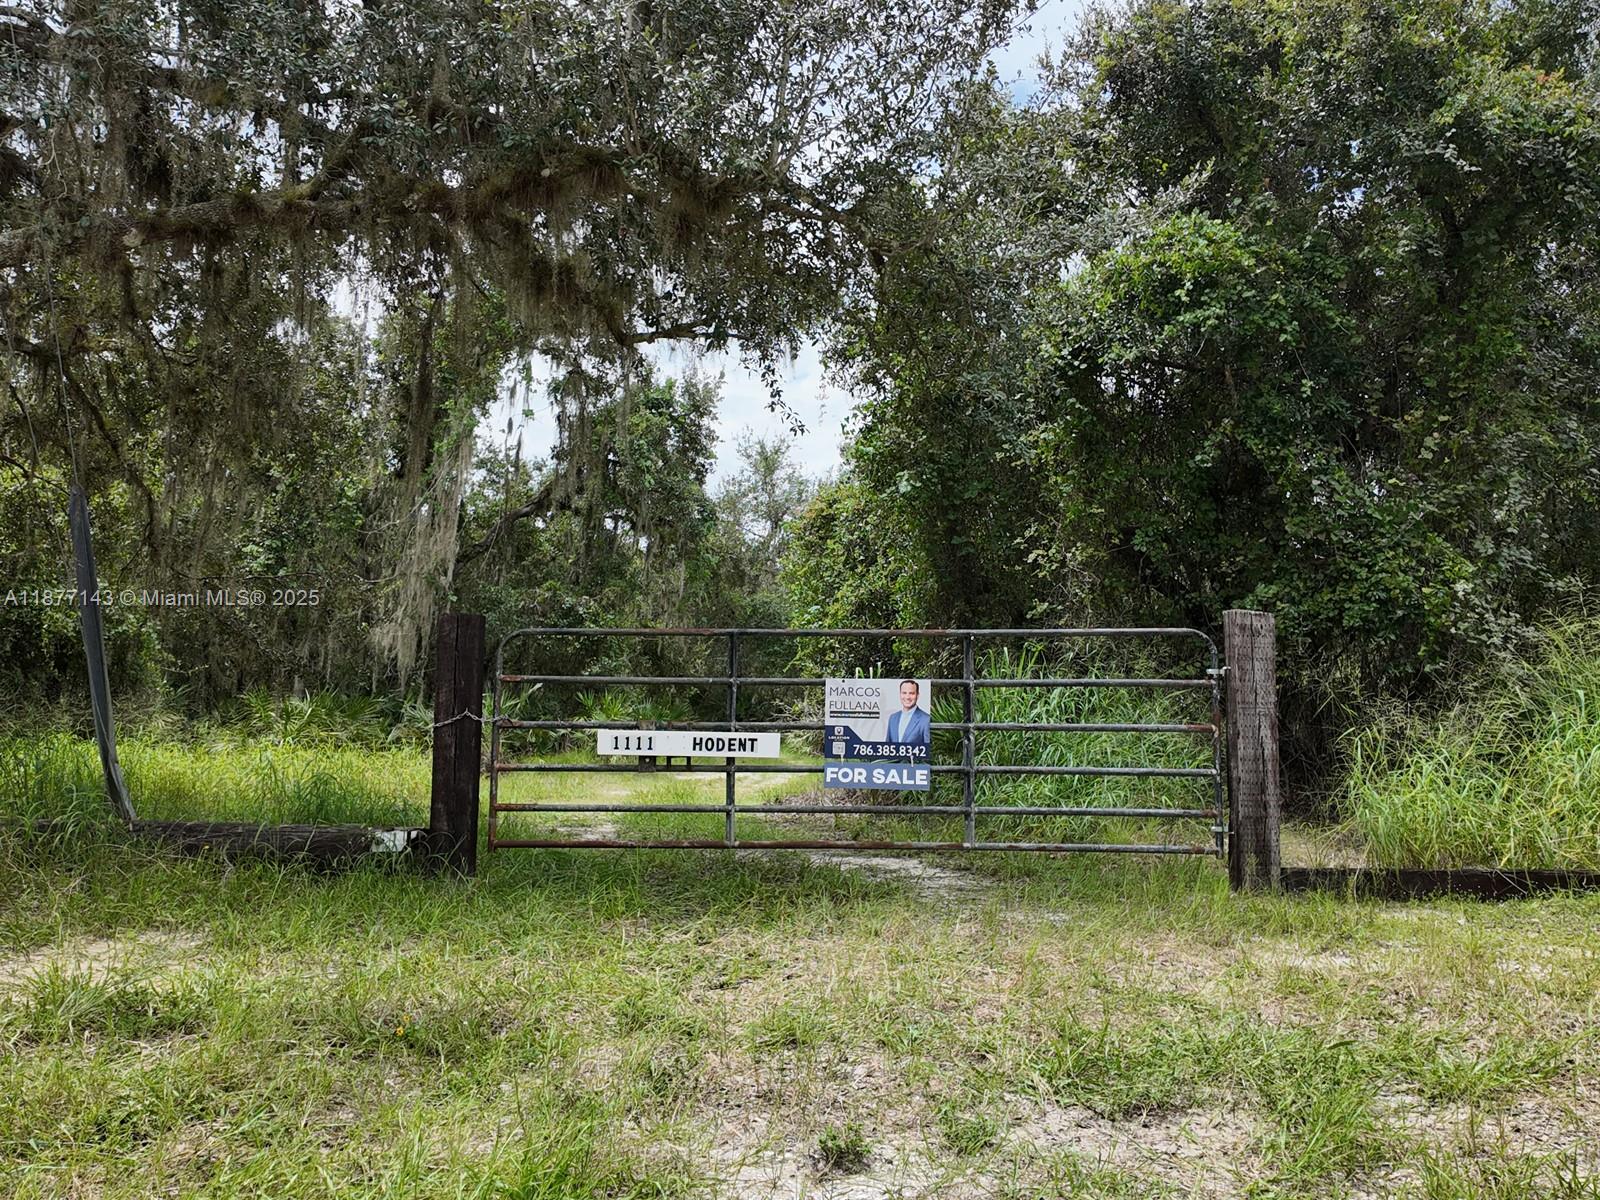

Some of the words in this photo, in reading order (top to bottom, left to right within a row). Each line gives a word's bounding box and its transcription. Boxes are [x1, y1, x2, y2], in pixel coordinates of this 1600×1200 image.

[829, 687, 881, 697] MARCOS
[829, 700, 880, 710] FULLANA
[613, 735, 654, 751] 1111
[692, 736, 758, 753] HODENT
[853, 744, 927, 757] 786.385.8342
[826, 767, 867, 784] FOR
[872, 768, 928, 785] SALE
